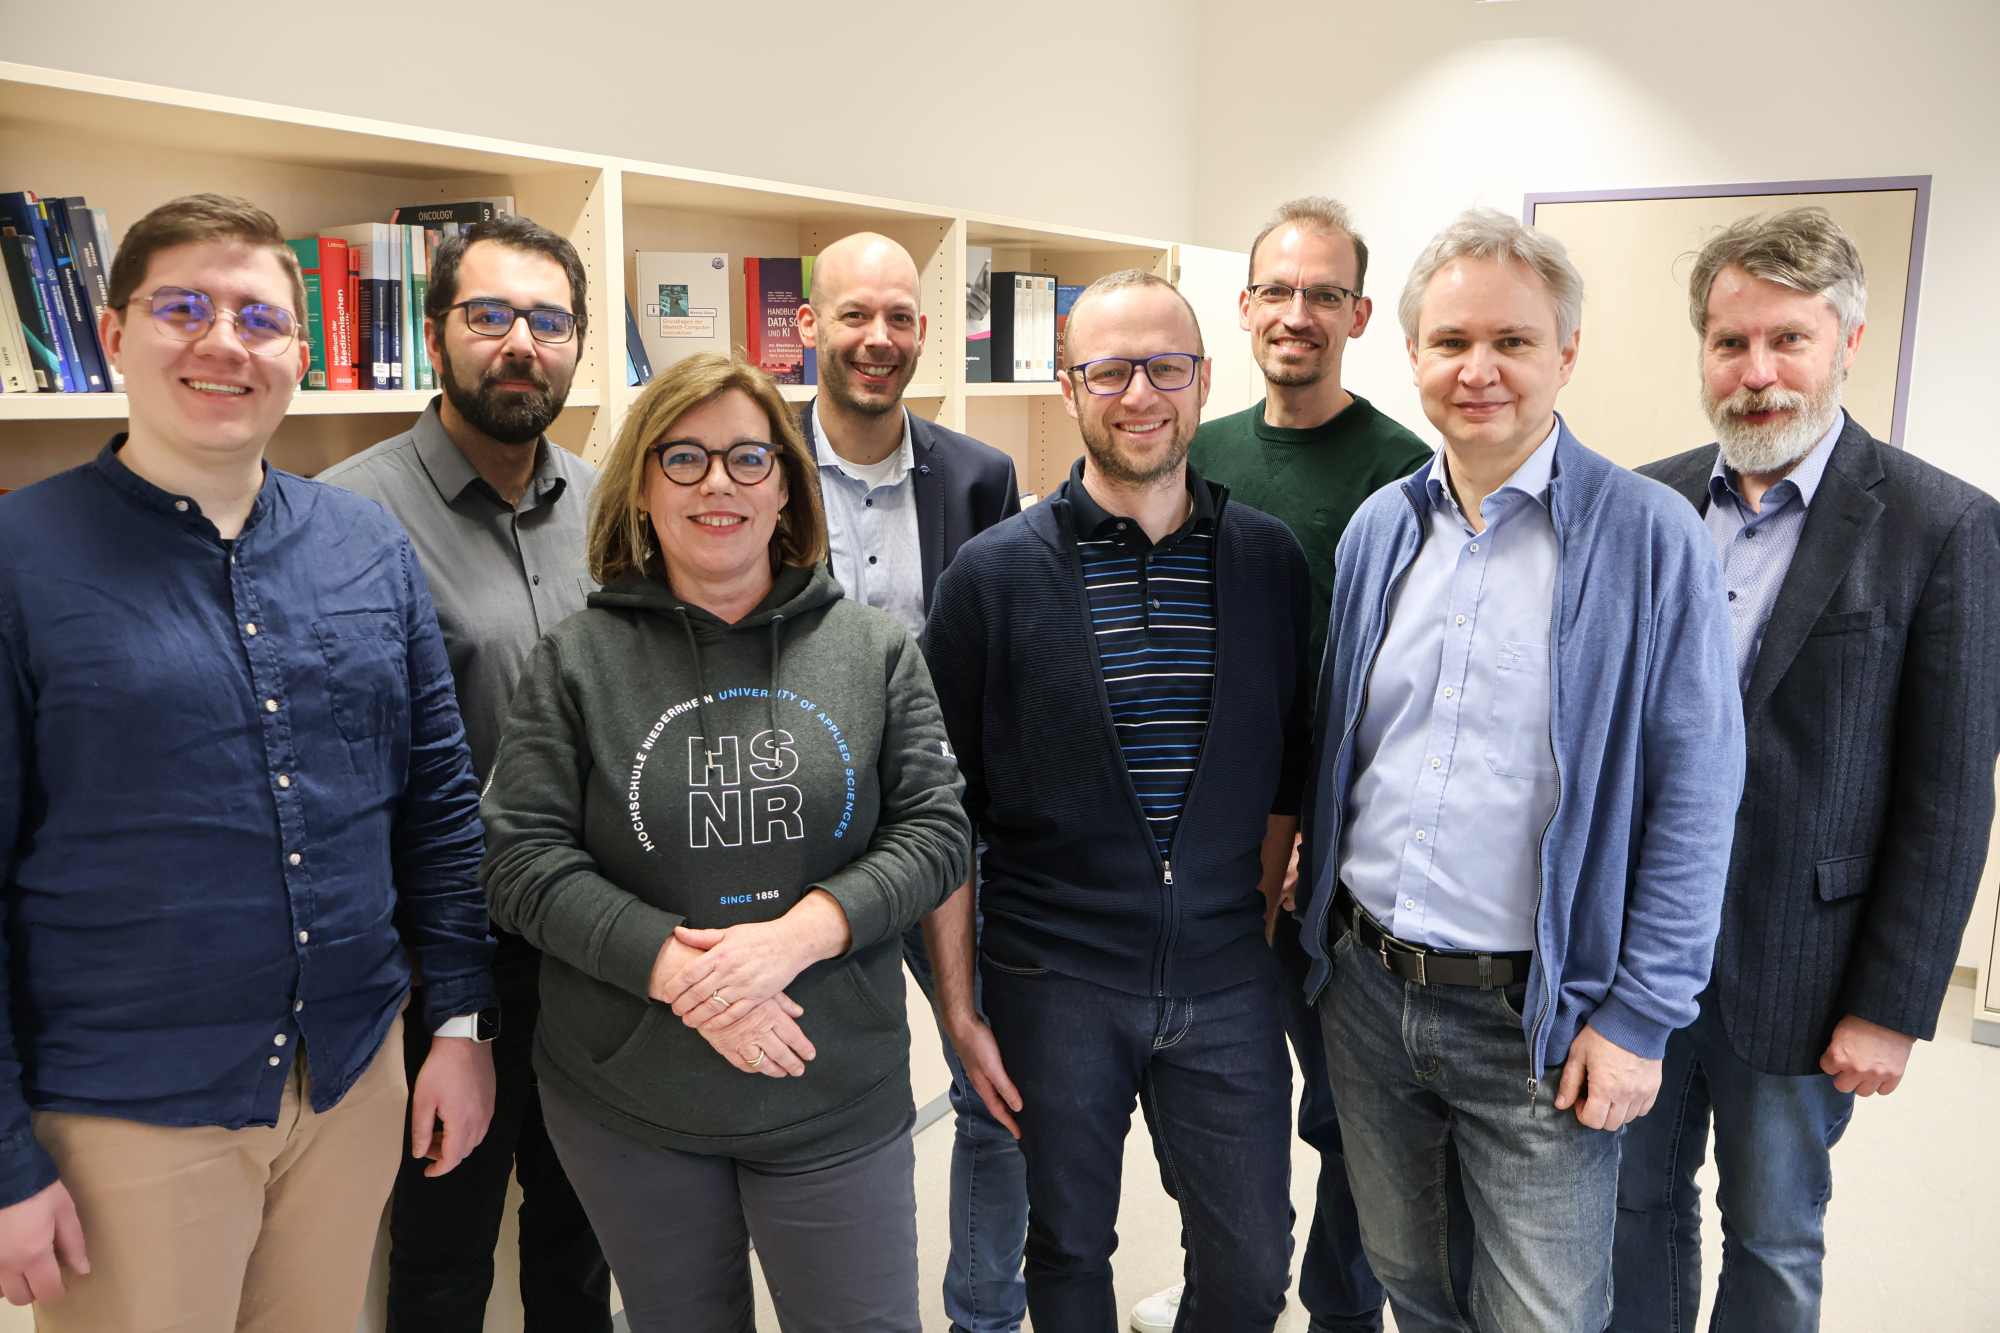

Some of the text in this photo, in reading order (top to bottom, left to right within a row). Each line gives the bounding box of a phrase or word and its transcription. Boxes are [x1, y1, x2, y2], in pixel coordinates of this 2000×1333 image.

[418, 209, 454, 221] ONCOLOGY
[83, 247, 93, 268] BRUHN
[88, 242, 98, 267] MEFFERT
[64, 268, 82, 322] Marktpsychologie
[46, 311, 58, 342] Medizinische
[54, 341, 64, 361] Statistik
[337, 289, 348, 366] Medizinischen
[767, 317, 788, 327] DATA
[767, 327, 791, 338] UND KI
[1, 346, 11, 367] GLANTZ
[628, 694, 714, 852] HOCHSCHULE NIEDERRHEN
[688, 729, 800, 787] HS
[718, 687, 856, 839] UNIVERITY OF APPLIED SCIENCES
[688, 783, 805, 849] NR
[719, 889, 780, 905] SINCE 1855
